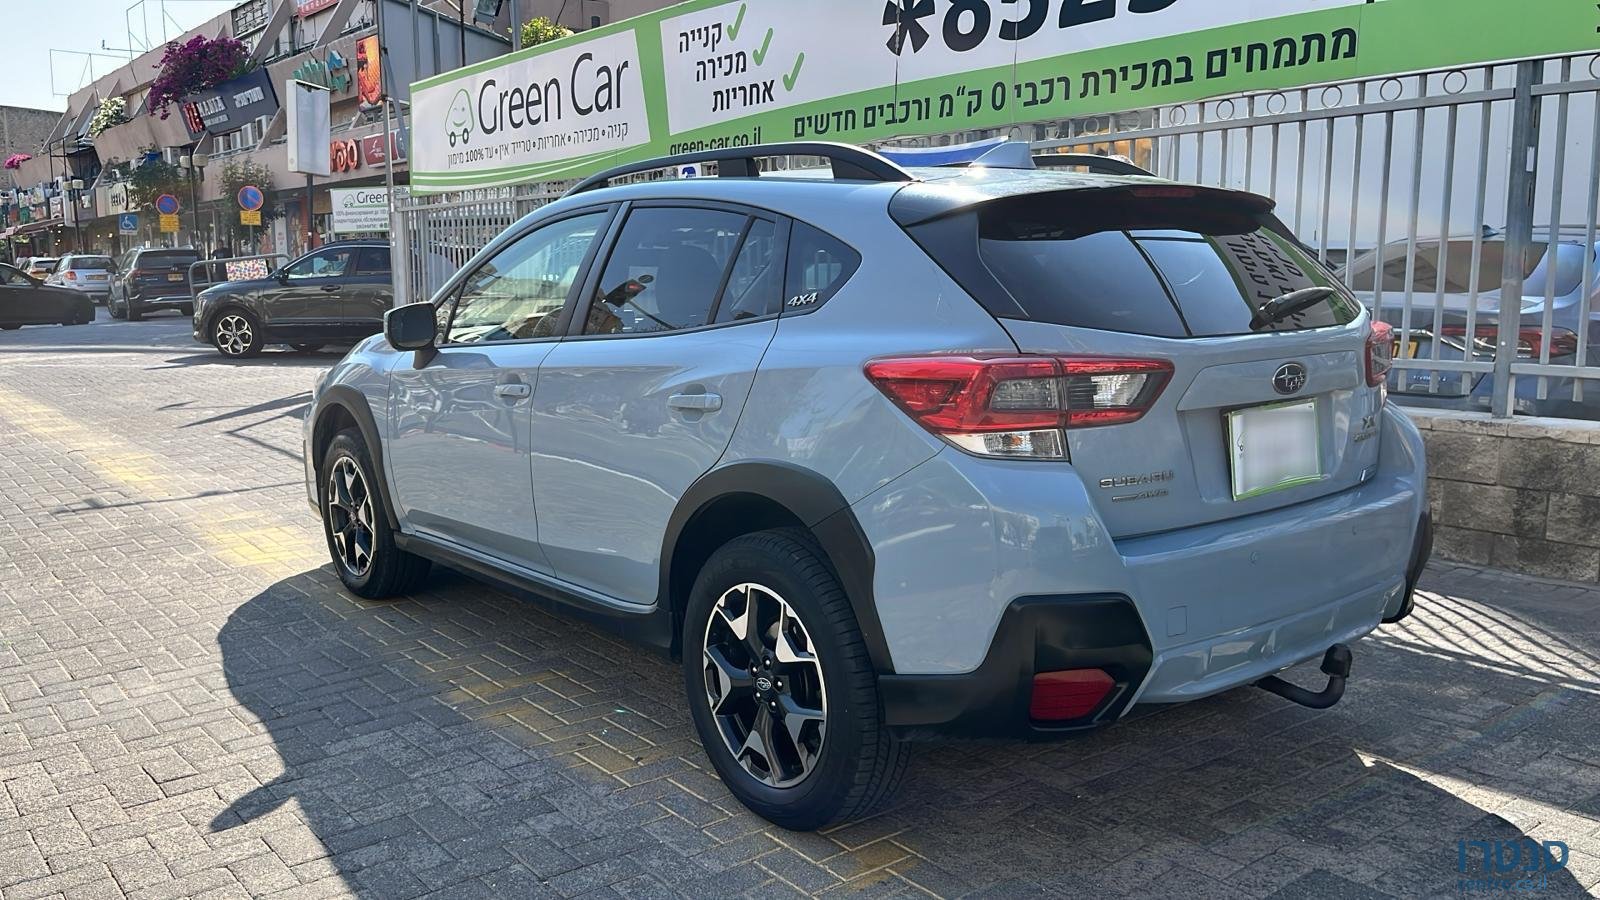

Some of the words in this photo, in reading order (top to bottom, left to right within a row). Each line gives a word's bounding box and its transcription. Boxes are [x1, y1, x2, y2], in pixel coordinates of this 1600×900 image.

[680, 22, 722, 53] קנייה
[696, 51, 747, 82] מכירה
[1205, 27, 1358, 79] מתמחים
[1080, 55, 1194, 98] במכירת
[478, 78, 562, 135] Green
[571, 52, 629, 116] Car
[712, 80, 775, 112] אחריות
[991, 81, 1007, 111] 0
[1014, 76, 1071, 108] רכבי
[794, 109, 856, 138] חדשים
[863, 96, 930, 128] ורכבים
[537, 133, 567, 151] אחריות
[573, 127, 600, 144] מכירה
[607, 122, 629, 142] קניה
[670, 126, 761, 156] green-car.co.il
[465, 148, 484, 162] 100%
[1099, 469, 1175, 488] SUBARU
